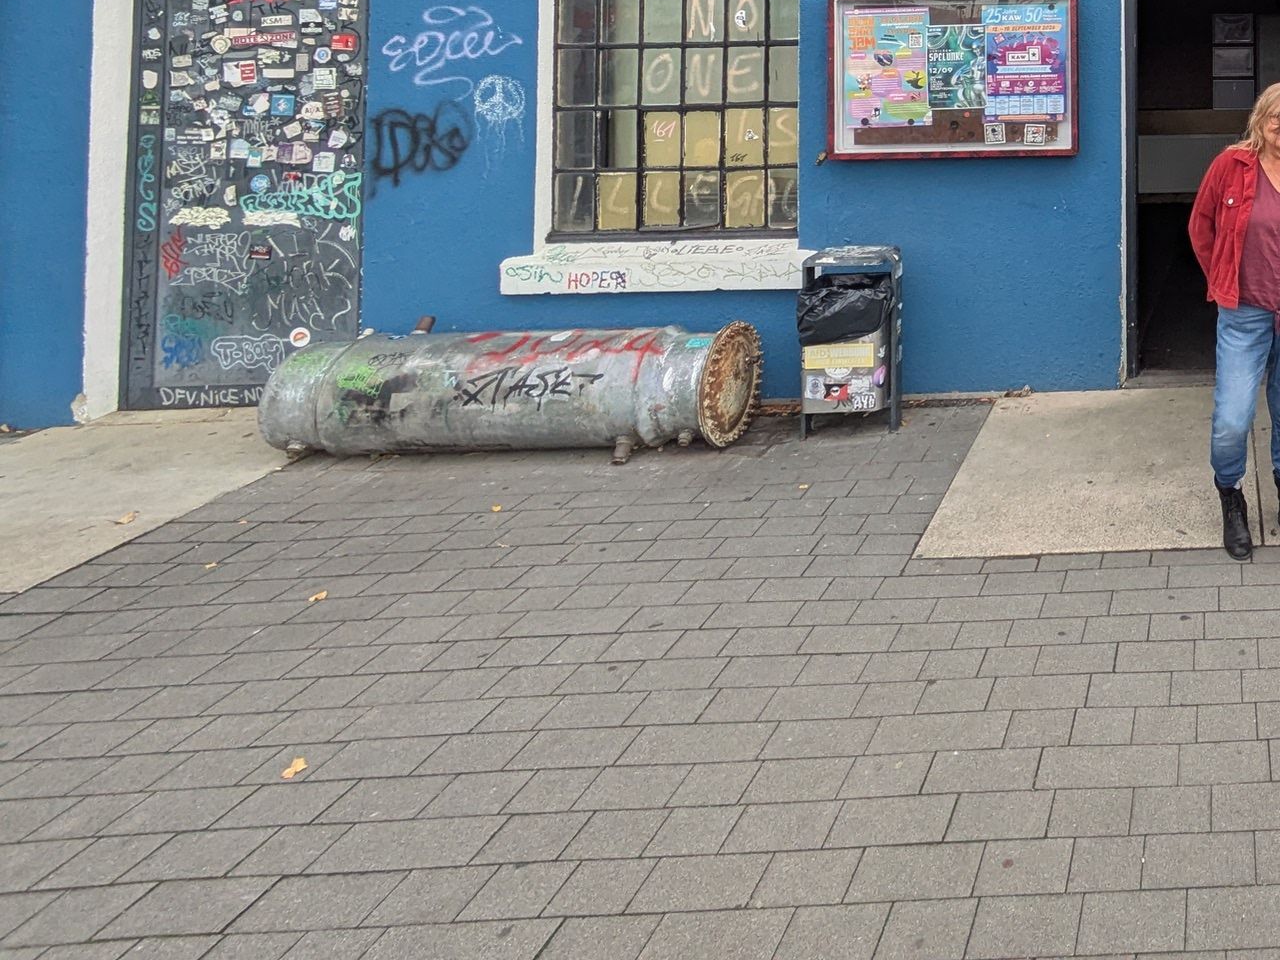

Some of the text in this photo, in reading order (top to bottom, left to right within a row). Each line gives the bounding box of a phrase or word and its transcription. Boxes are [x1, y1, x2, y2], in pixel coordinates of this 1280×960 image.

[986, 7, 1001, 23] 25
[1025, 6, 1043, 23] 50
[929, 52, 964, 62] SPELUNKE
[645, 51, 761, 96] ONE
